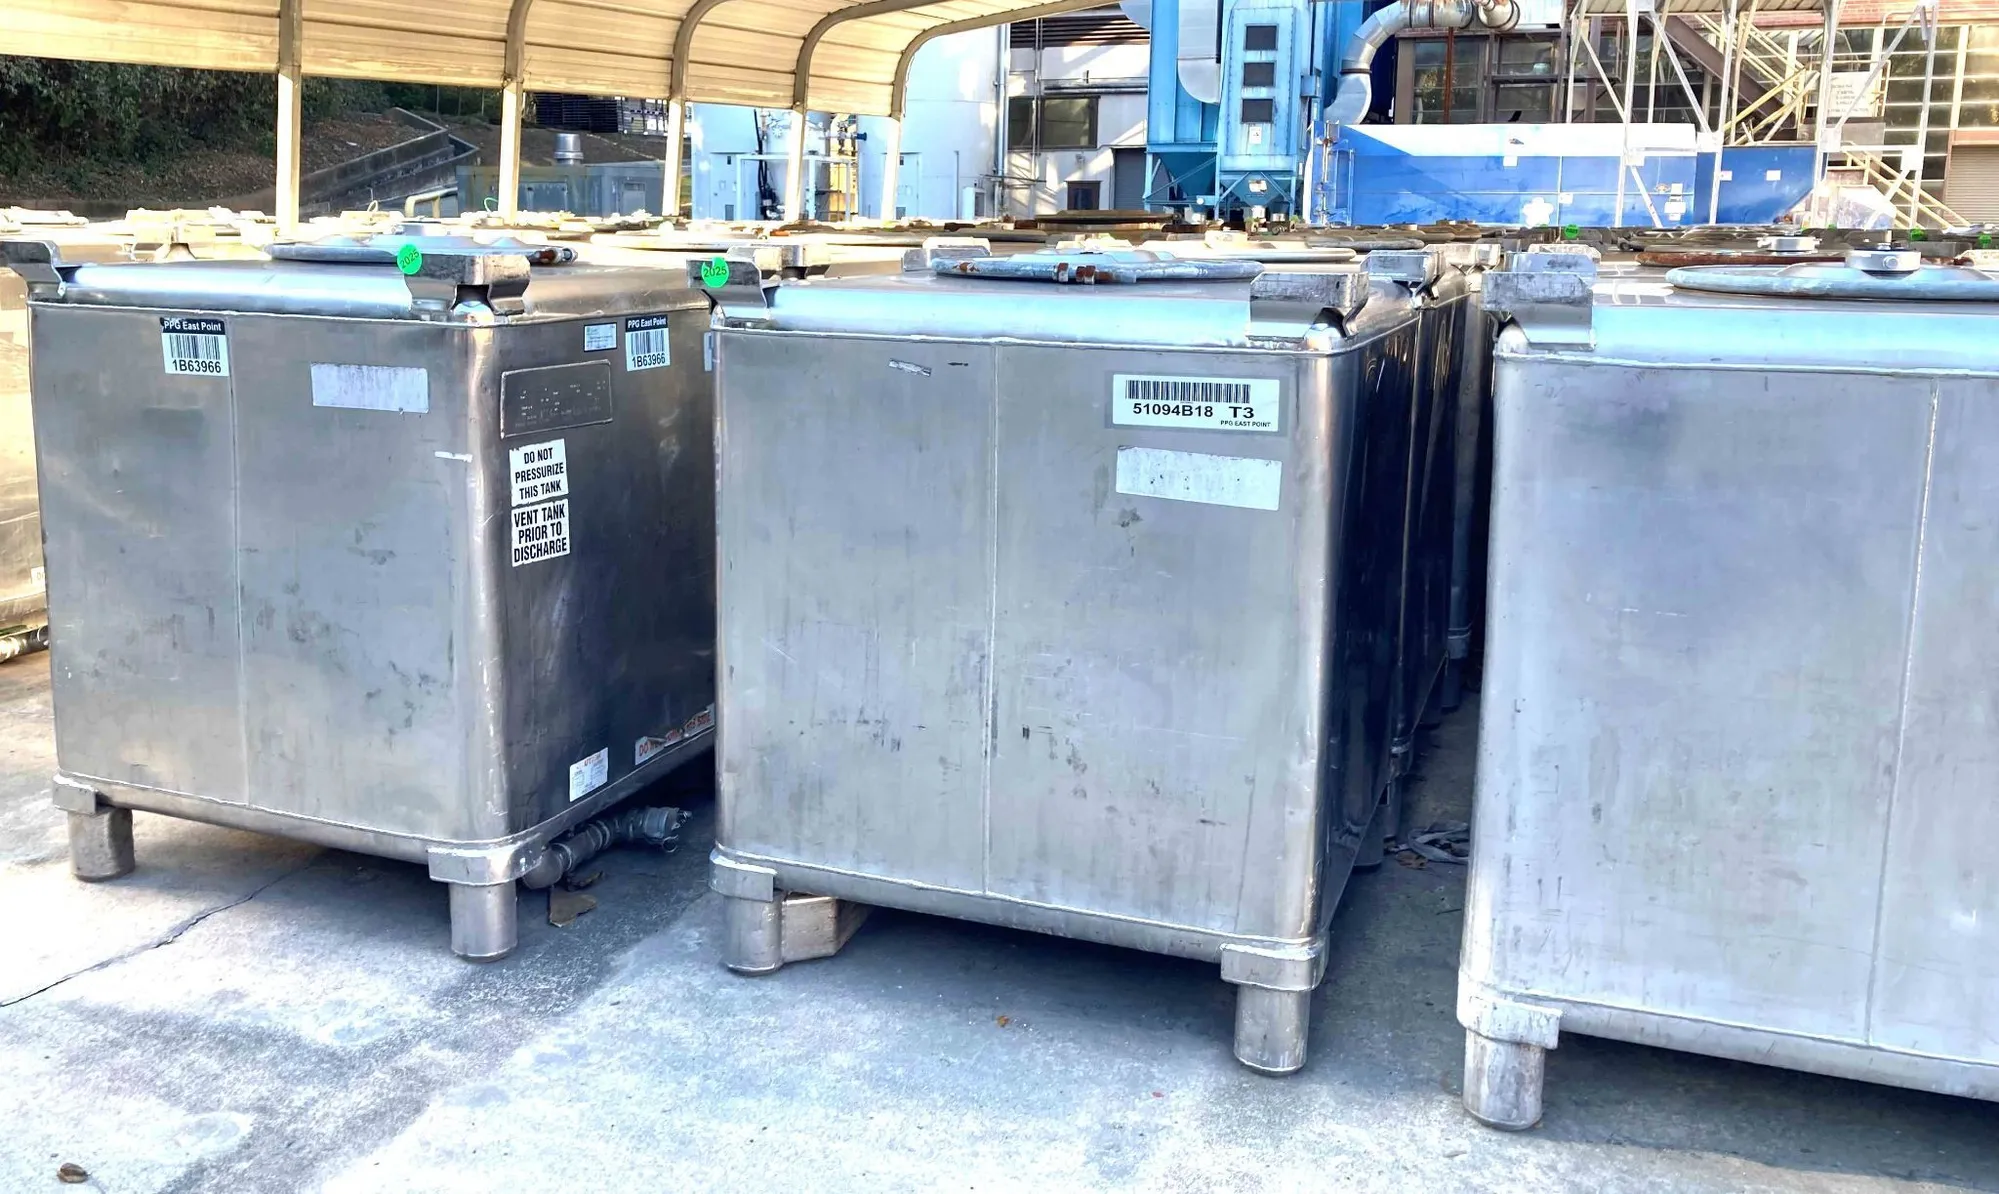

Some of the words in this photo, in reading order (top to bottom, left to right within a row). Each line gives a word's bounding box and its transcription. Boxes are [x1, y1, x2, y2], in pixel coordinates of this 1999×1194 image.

[399, 249, 420, 269] 2025
[703, 266, 727, 278] 2025
[164, 320, 181, 330] PPG
[182, 321, 200, 331] East
[201, 321, 222, 331] Point
[627, 320, 640, 329] PPG
[640, 319, 653, 328] East
[653, 317, 667, 326] Point
[172, 359, 222, 374] 1B63966
[631, 352, 666, 368] 1B63966
[1132, 402, 1214, 418] 51094B18
[1228, 406, 1254, 419] T3
[523, 451, 536, 465] DO
[537, 447, 553, 462] NOT
[514, 462, 565, 484] PRESSURIZE
[519, 485, 539, 500] THIS
[540, 479, 562, 496] TANK
[514, 509, 539, 528] VENT
[541, 503, 566, 522] TANK
[518, 524, 548, 545] PRIOR
[550, 521, 563, 538] TO
[513, 537, 567, 563] DISCHARGE
